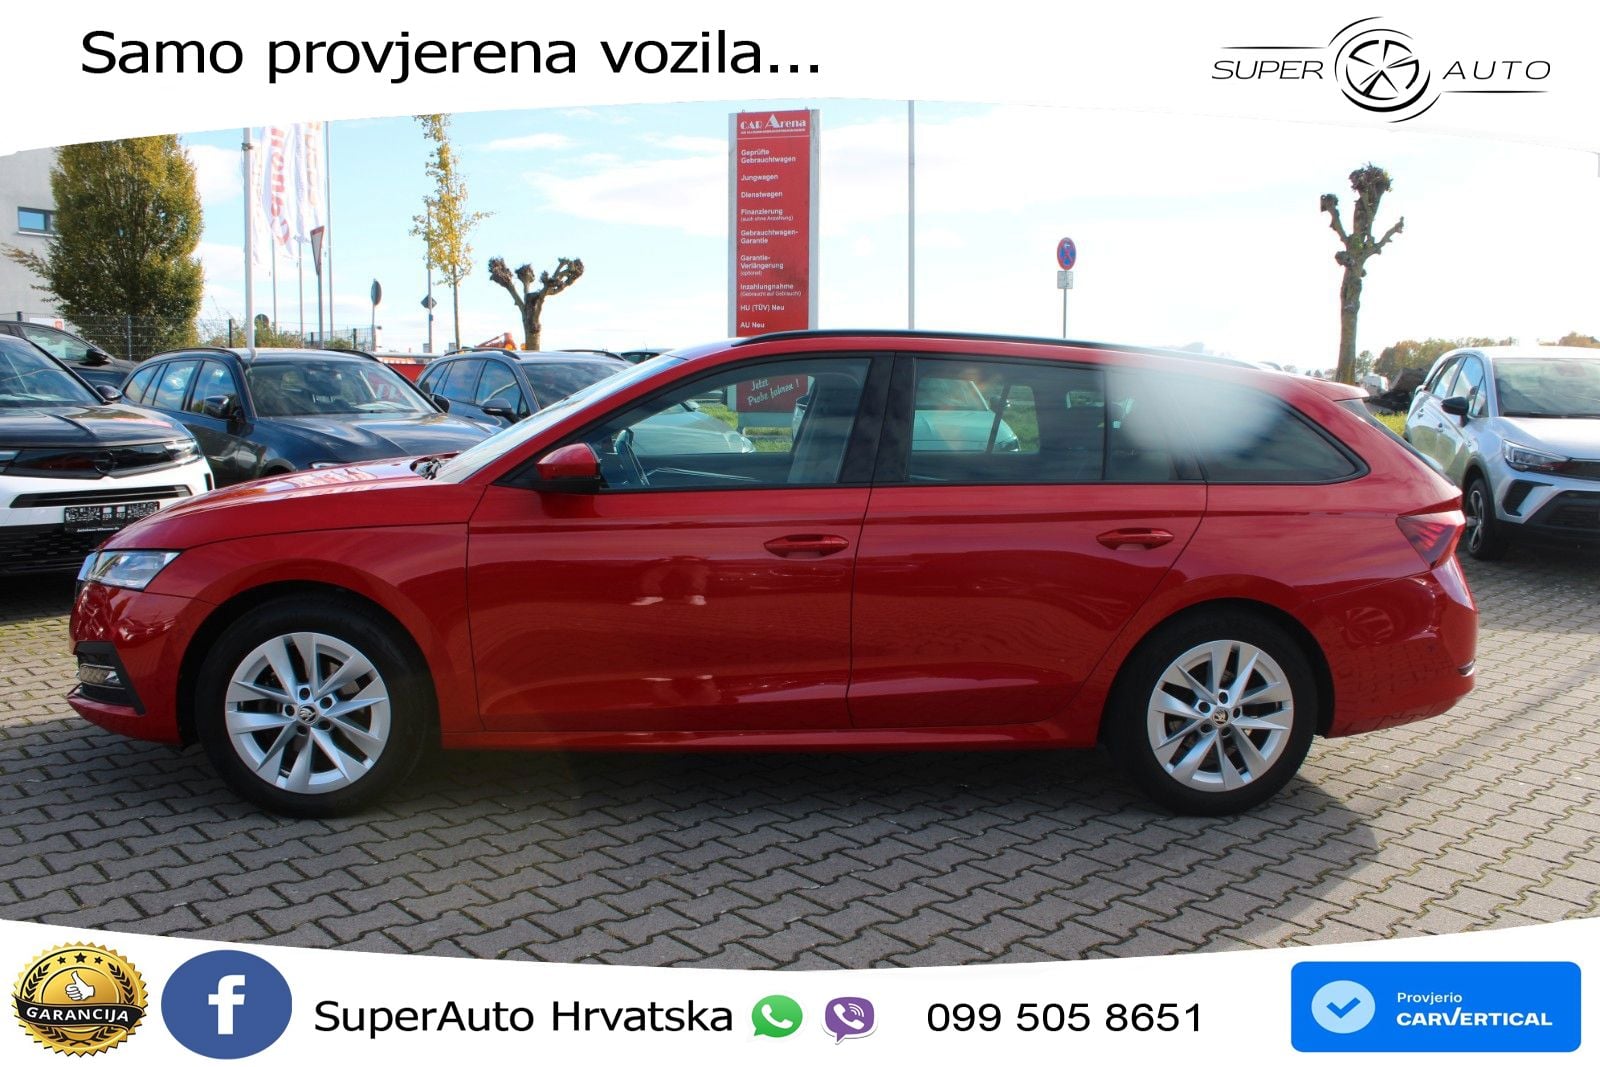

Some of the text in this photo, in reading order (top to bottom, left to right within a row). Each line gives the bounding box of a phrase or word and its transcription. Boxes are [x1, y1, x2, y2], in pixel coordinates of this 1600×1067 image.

[765, 114, 807, 129] Arena
[741, 149, 770, 157] Geprüfte
[741, 156, 796, 164] Gebrauchtwagen
[740, 174, 779, 182] Jungwagen
[740, 191, 783, 199] Dienstwagen
[740, 208, 784, 216] Finanzierung
[740, 229, 799, 237] Gebrauchtwagen-
[740, 254, 771, 262] Garantie-
[740, 262, 784, 270] Verlängerung
[740, 283, 794, 291] Inzahlungnahme
[752, 303, 770, 312] (TÜV)
[771, 304, 785, 312] Neu
[740, 321, 765, 329] AU Neu
